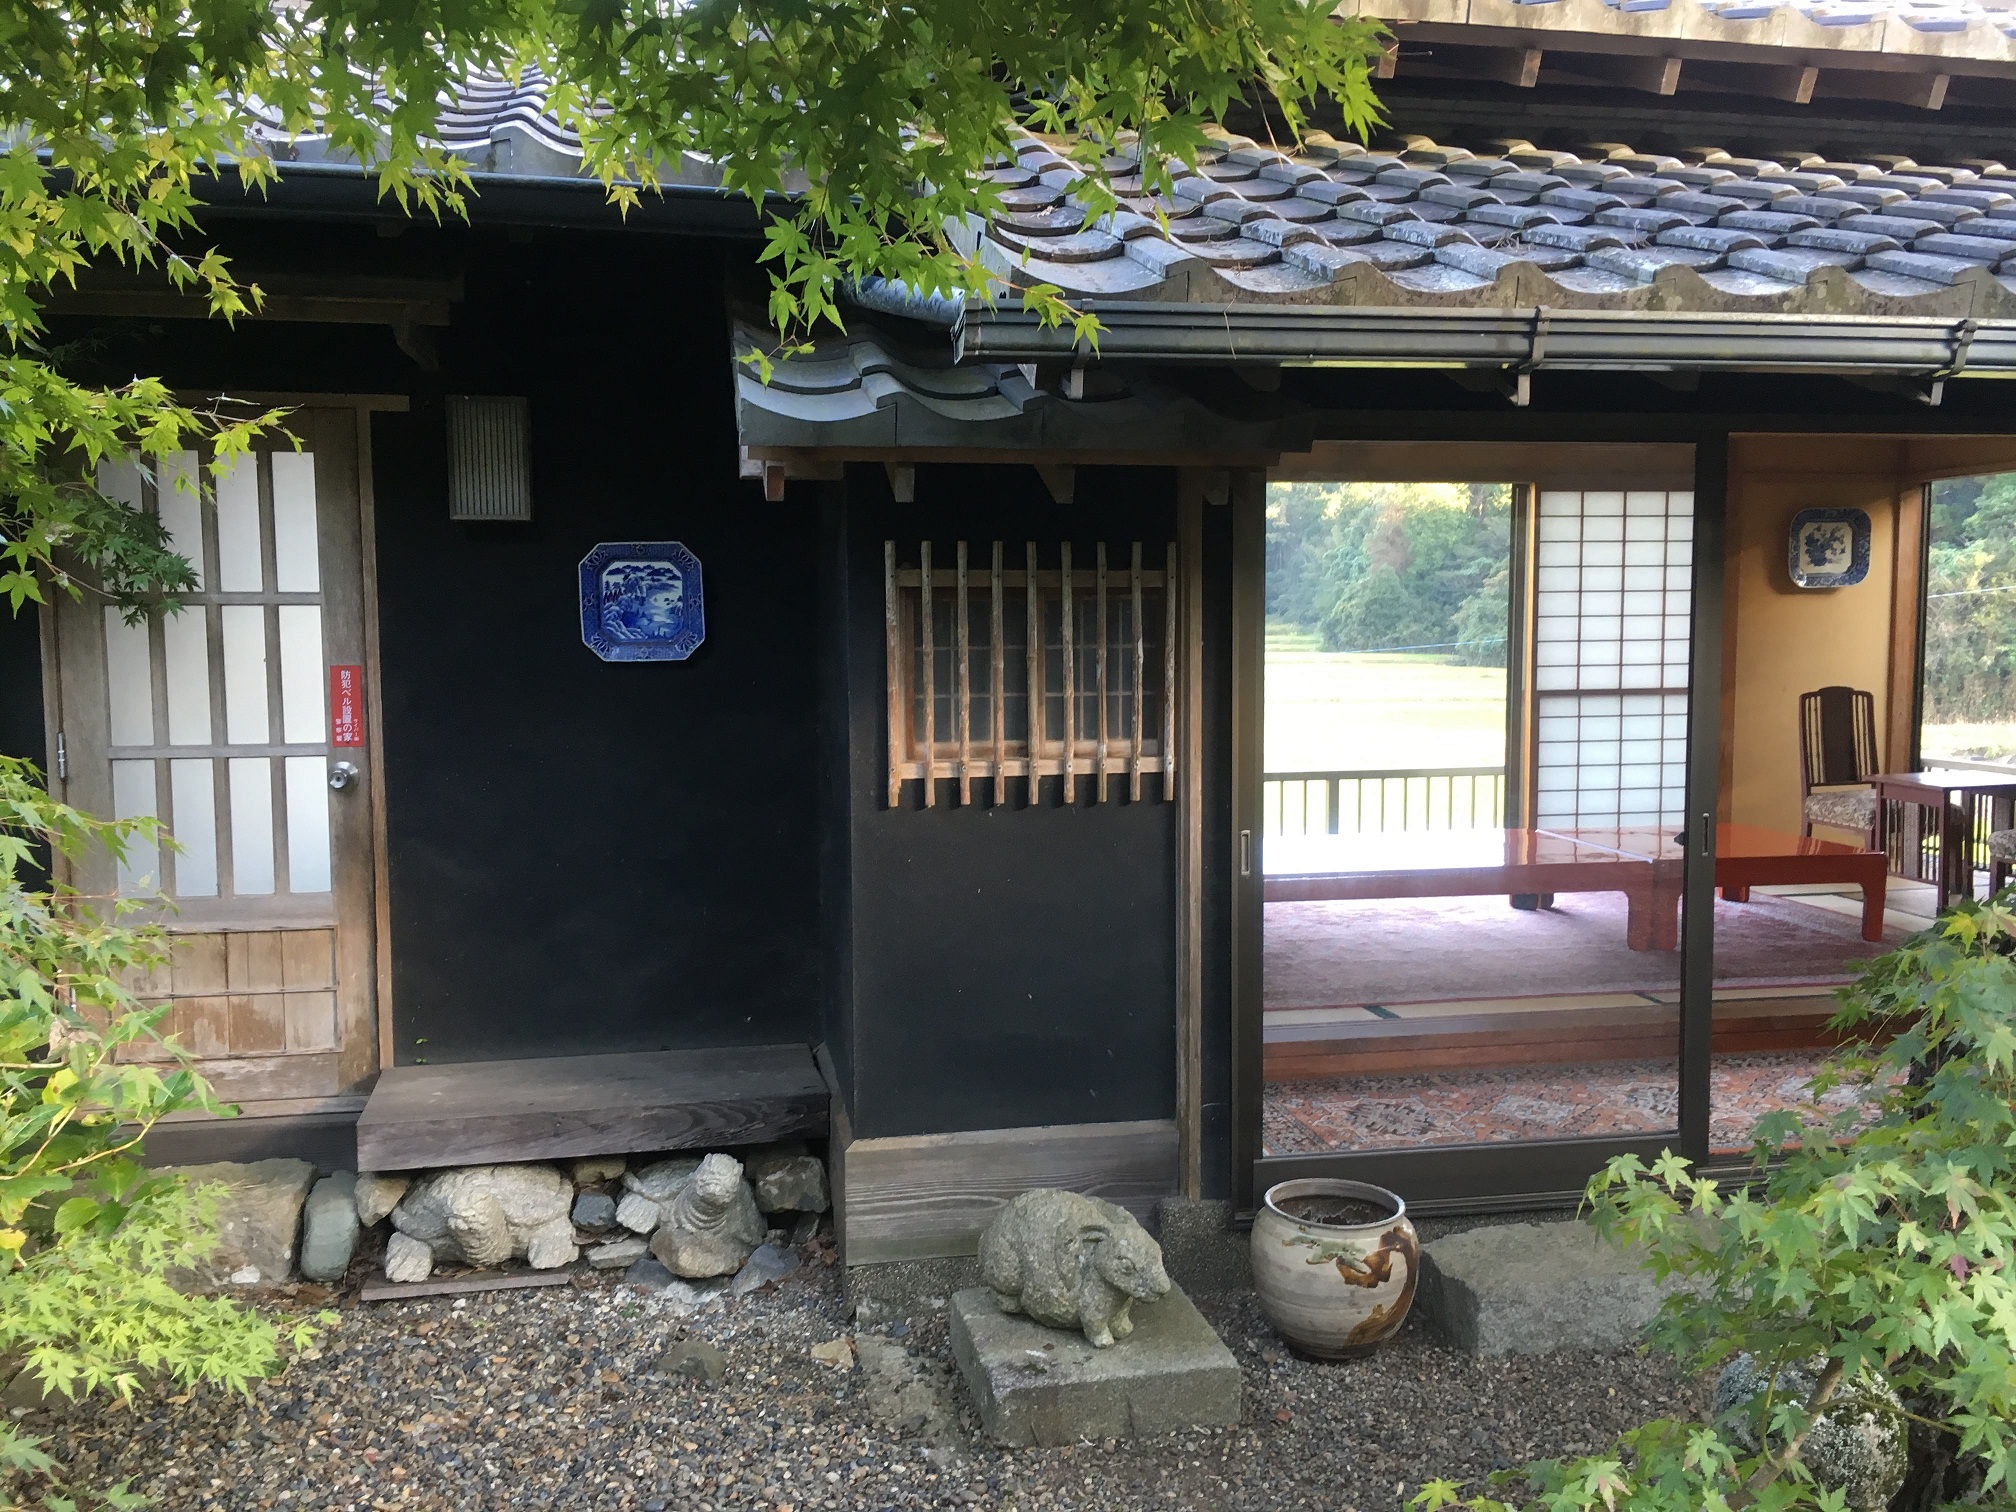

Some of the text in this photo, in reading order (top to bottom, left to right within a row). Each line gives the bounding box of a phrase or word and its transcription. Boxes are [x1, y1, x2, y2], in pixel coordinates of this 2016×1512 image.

[340, 670, 353, 742] 防犯ベル設置の家
